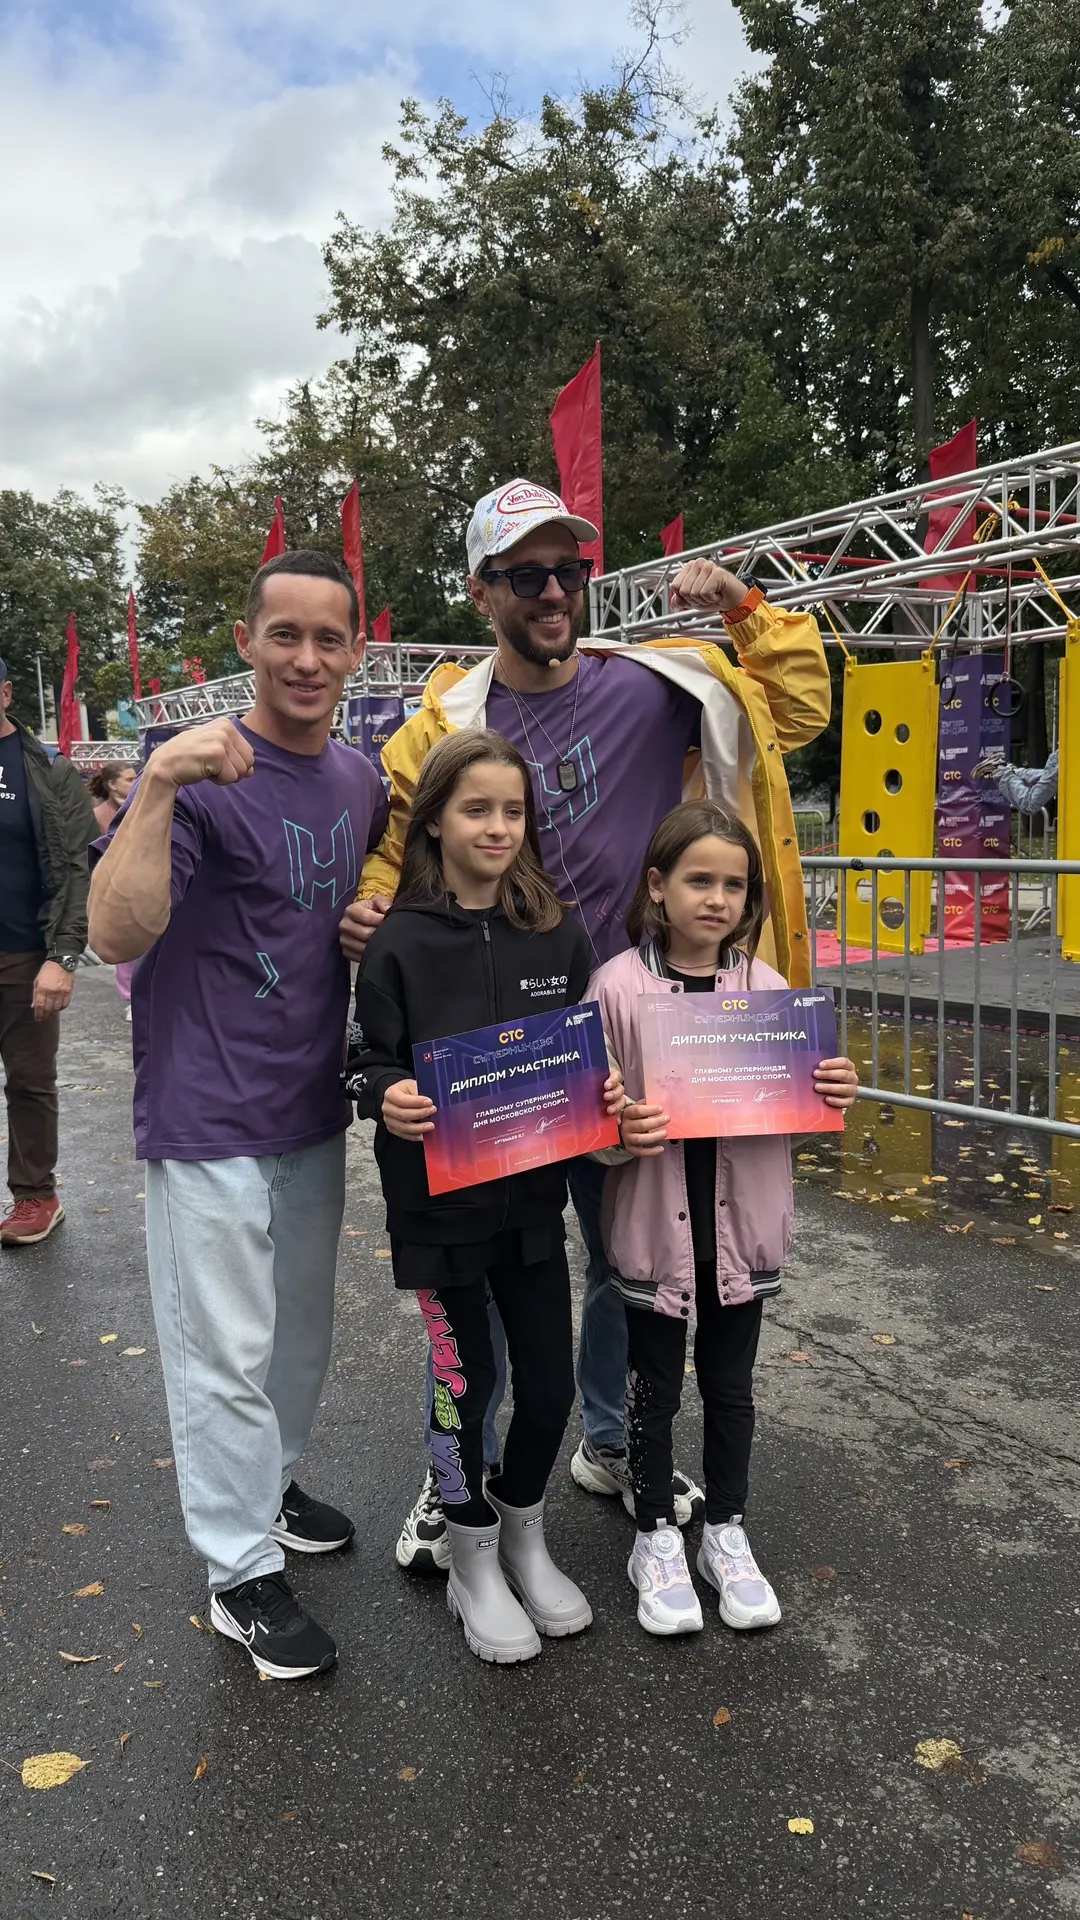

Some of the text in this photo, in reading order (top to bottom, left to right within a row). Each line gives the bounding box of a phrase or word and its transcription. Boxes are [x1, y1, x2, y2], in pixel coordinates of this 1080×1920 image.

[0, 792, 16, 800] 952
[530, 989, 556, 997] ADORABLE
[721, 999, 749, 1011] СТС
[499, 1028, 525, 1045] СТС
[670, 1031, 807, 1046] ДИПЛОМ УЧАСТНИКА
[450, 1050, 580, 1095] ДИПЛОМ УЧАСТНИКА
[694, 1065, 787, 1075] ГЛАВНОМУ СУПЕРНИНДЗЯ
[476, 1089, 565, 1118] ГЛАВНОМУ СУПЕРНИНДЗЯ
[473, 1097, 570, 1129] ДНЯ МОСКОВСКОГО СПОРТА
